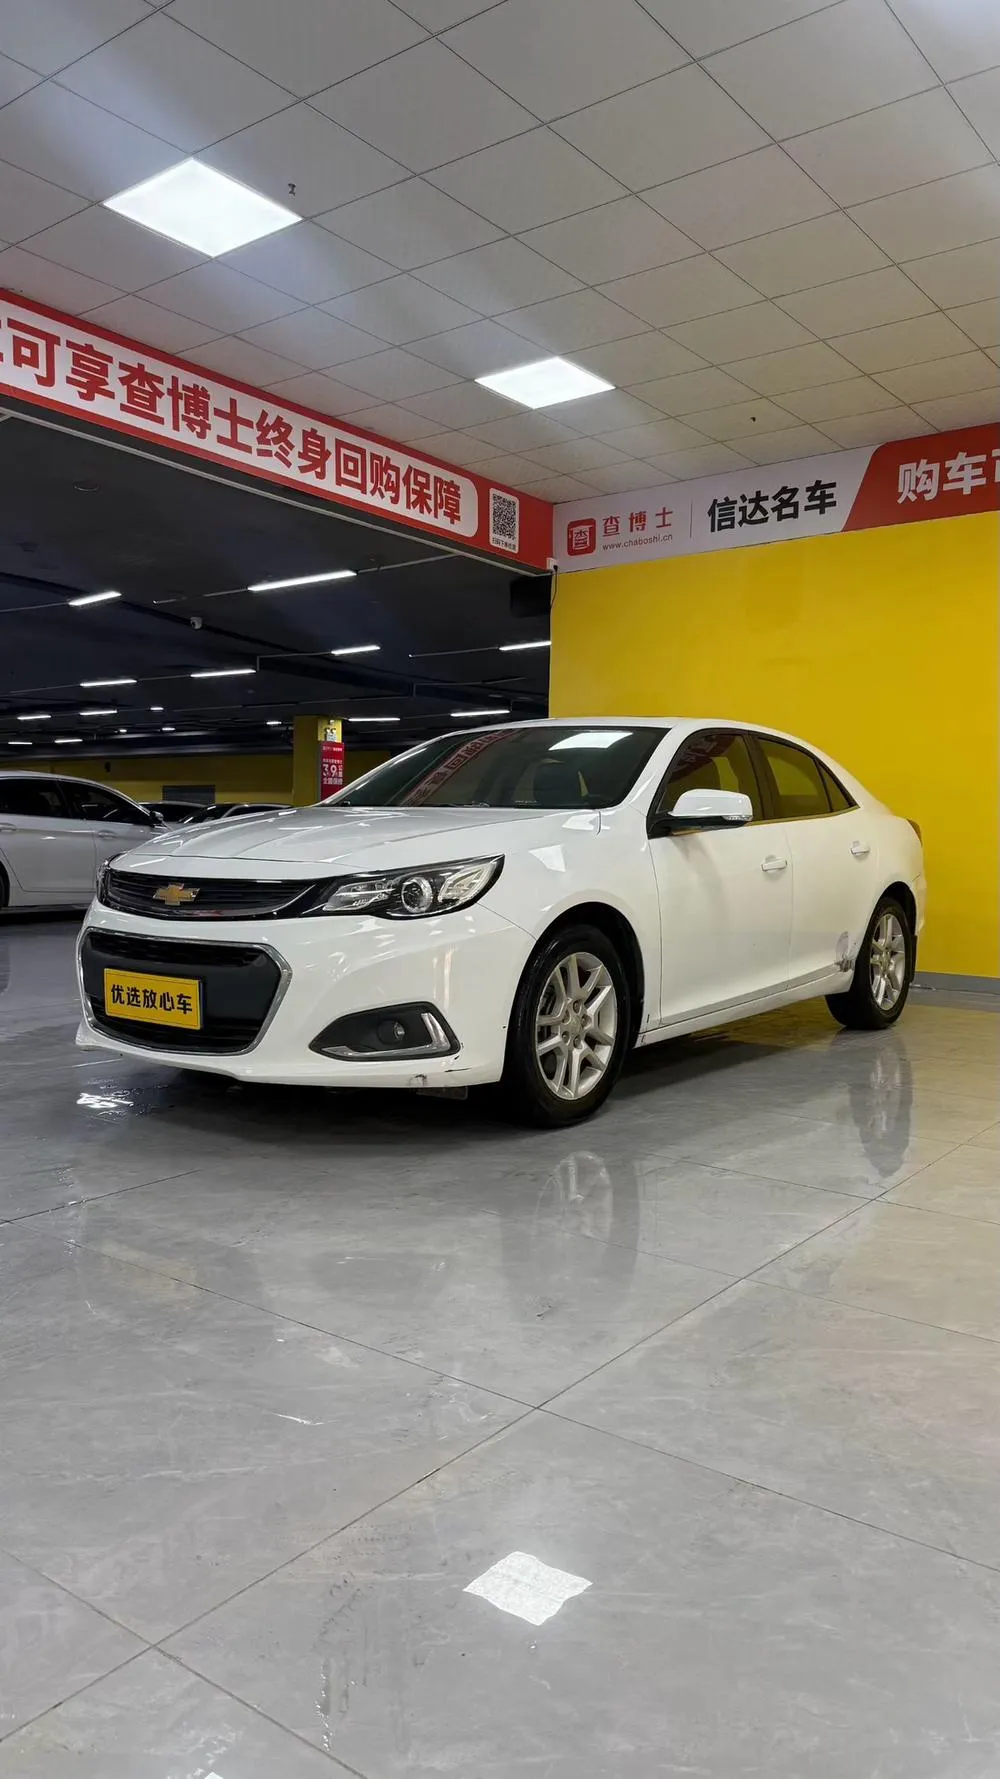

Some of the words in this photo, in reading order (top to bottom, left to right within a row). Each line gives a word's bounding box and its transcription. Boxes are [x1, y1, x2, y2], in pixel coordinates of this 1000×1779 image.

[0, 317, 461, 525] 可享查博士终身回购保障
[897, 448, 1000, 504] 购车
[602, 506, 673, 537] 查博士
[707, 480, 837, 533] 信达名车
[602, 533, 673, 551] www.chaboshi.cn
[111, 983, 193, 1015] 优选放心车
